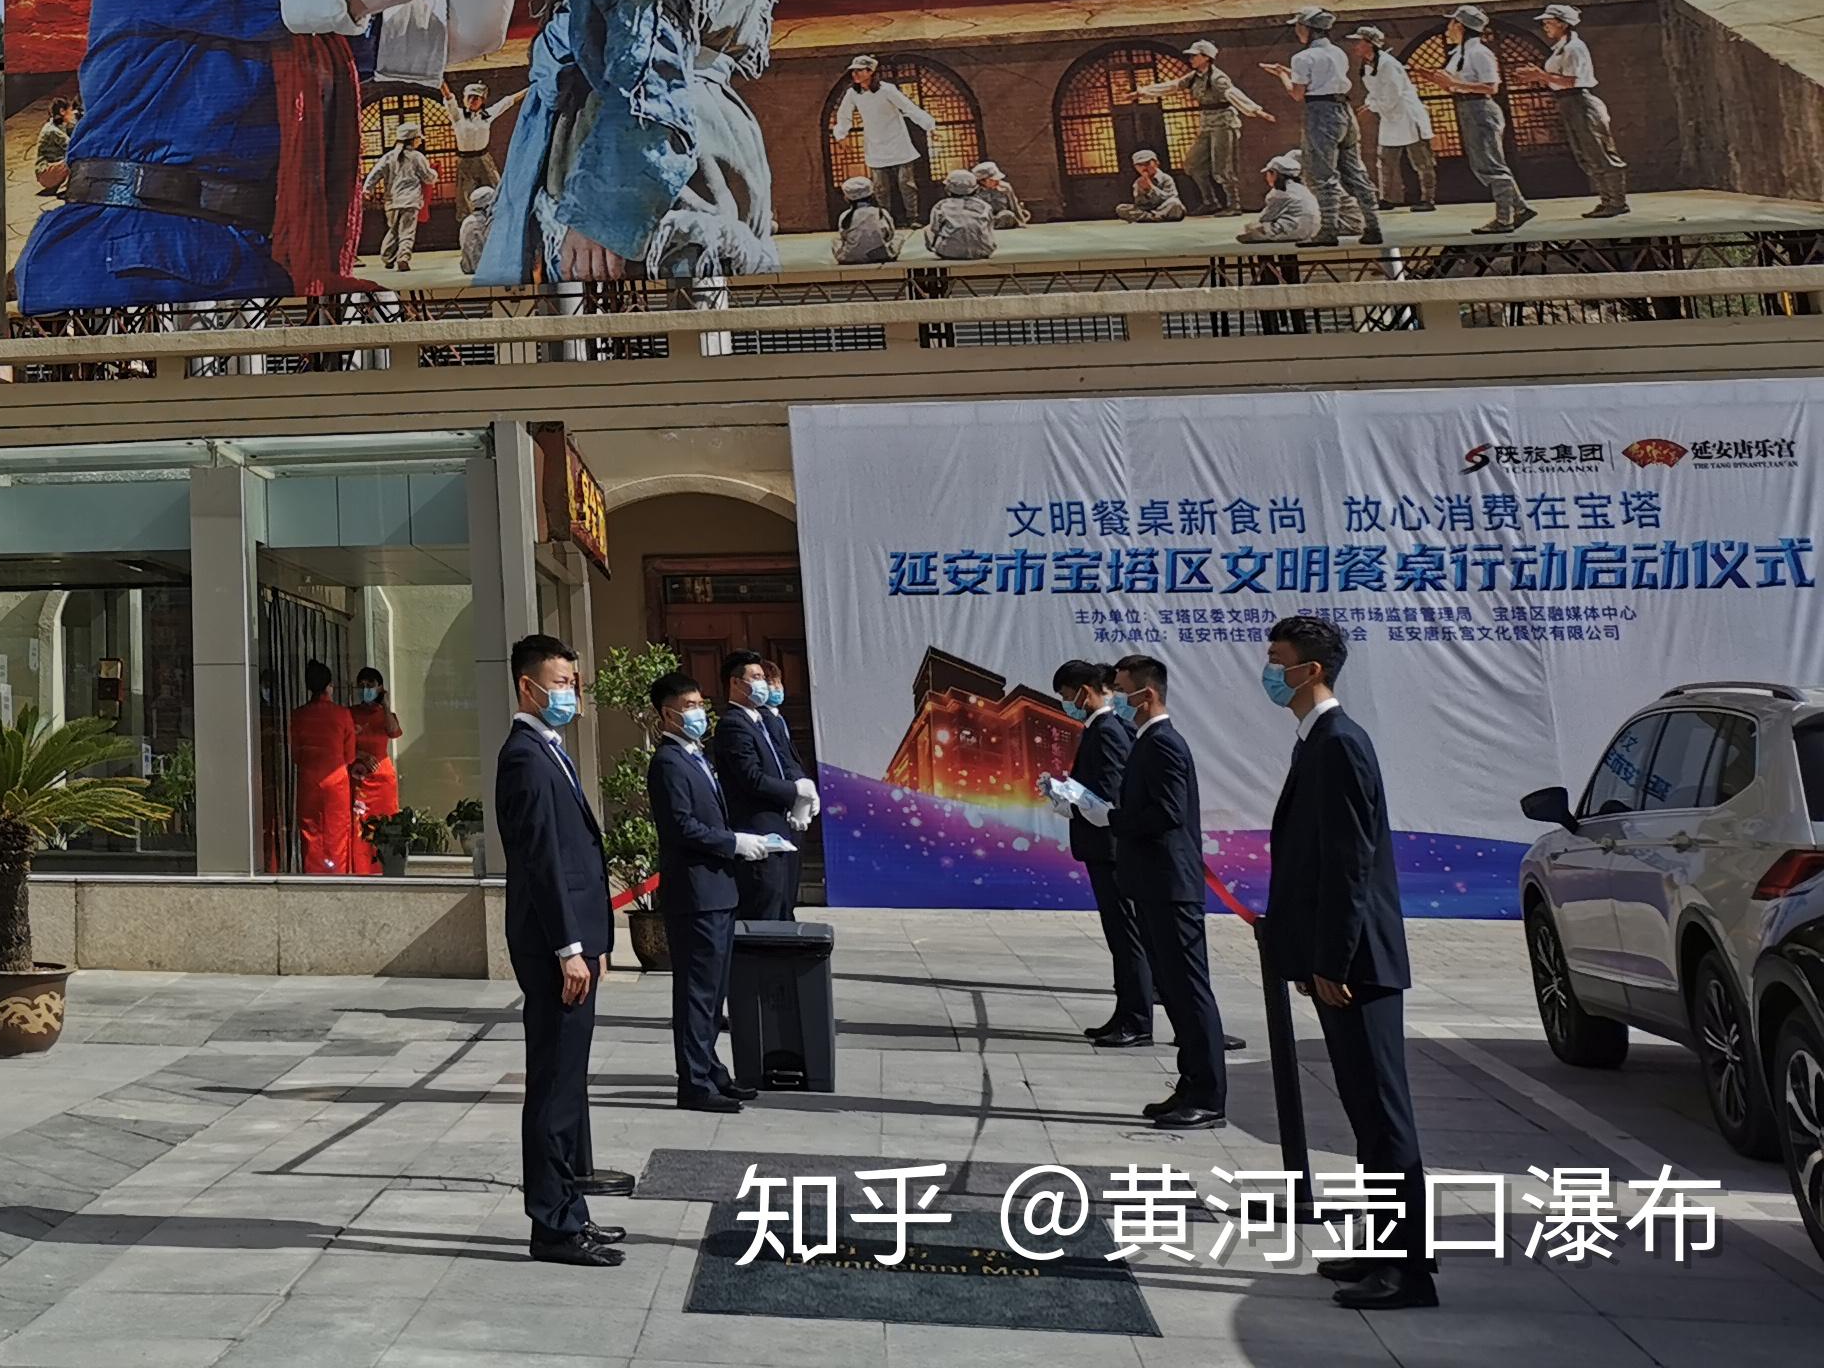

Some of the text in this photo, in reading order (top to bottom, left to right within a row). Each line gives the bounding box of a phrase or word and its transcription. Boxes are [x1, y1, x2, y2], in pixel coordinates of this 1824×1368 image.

[1494, 443, 1605, 465] 陕旅集团
[1690, 438, 1795, 460] 延安唐乐宫
[1006, 489, 1662, 538] 文明餐桌新食尚 放心消费在宝塔
[887, 537, 1816, 596] 延安市宝塔区文明餐桌行动启动仪式
[1492, 605, 1637, 623] 宝塔区融媒体中心
[1388, 624, 1621, 642] 延安唐乐宫文化餐饮有限公司
